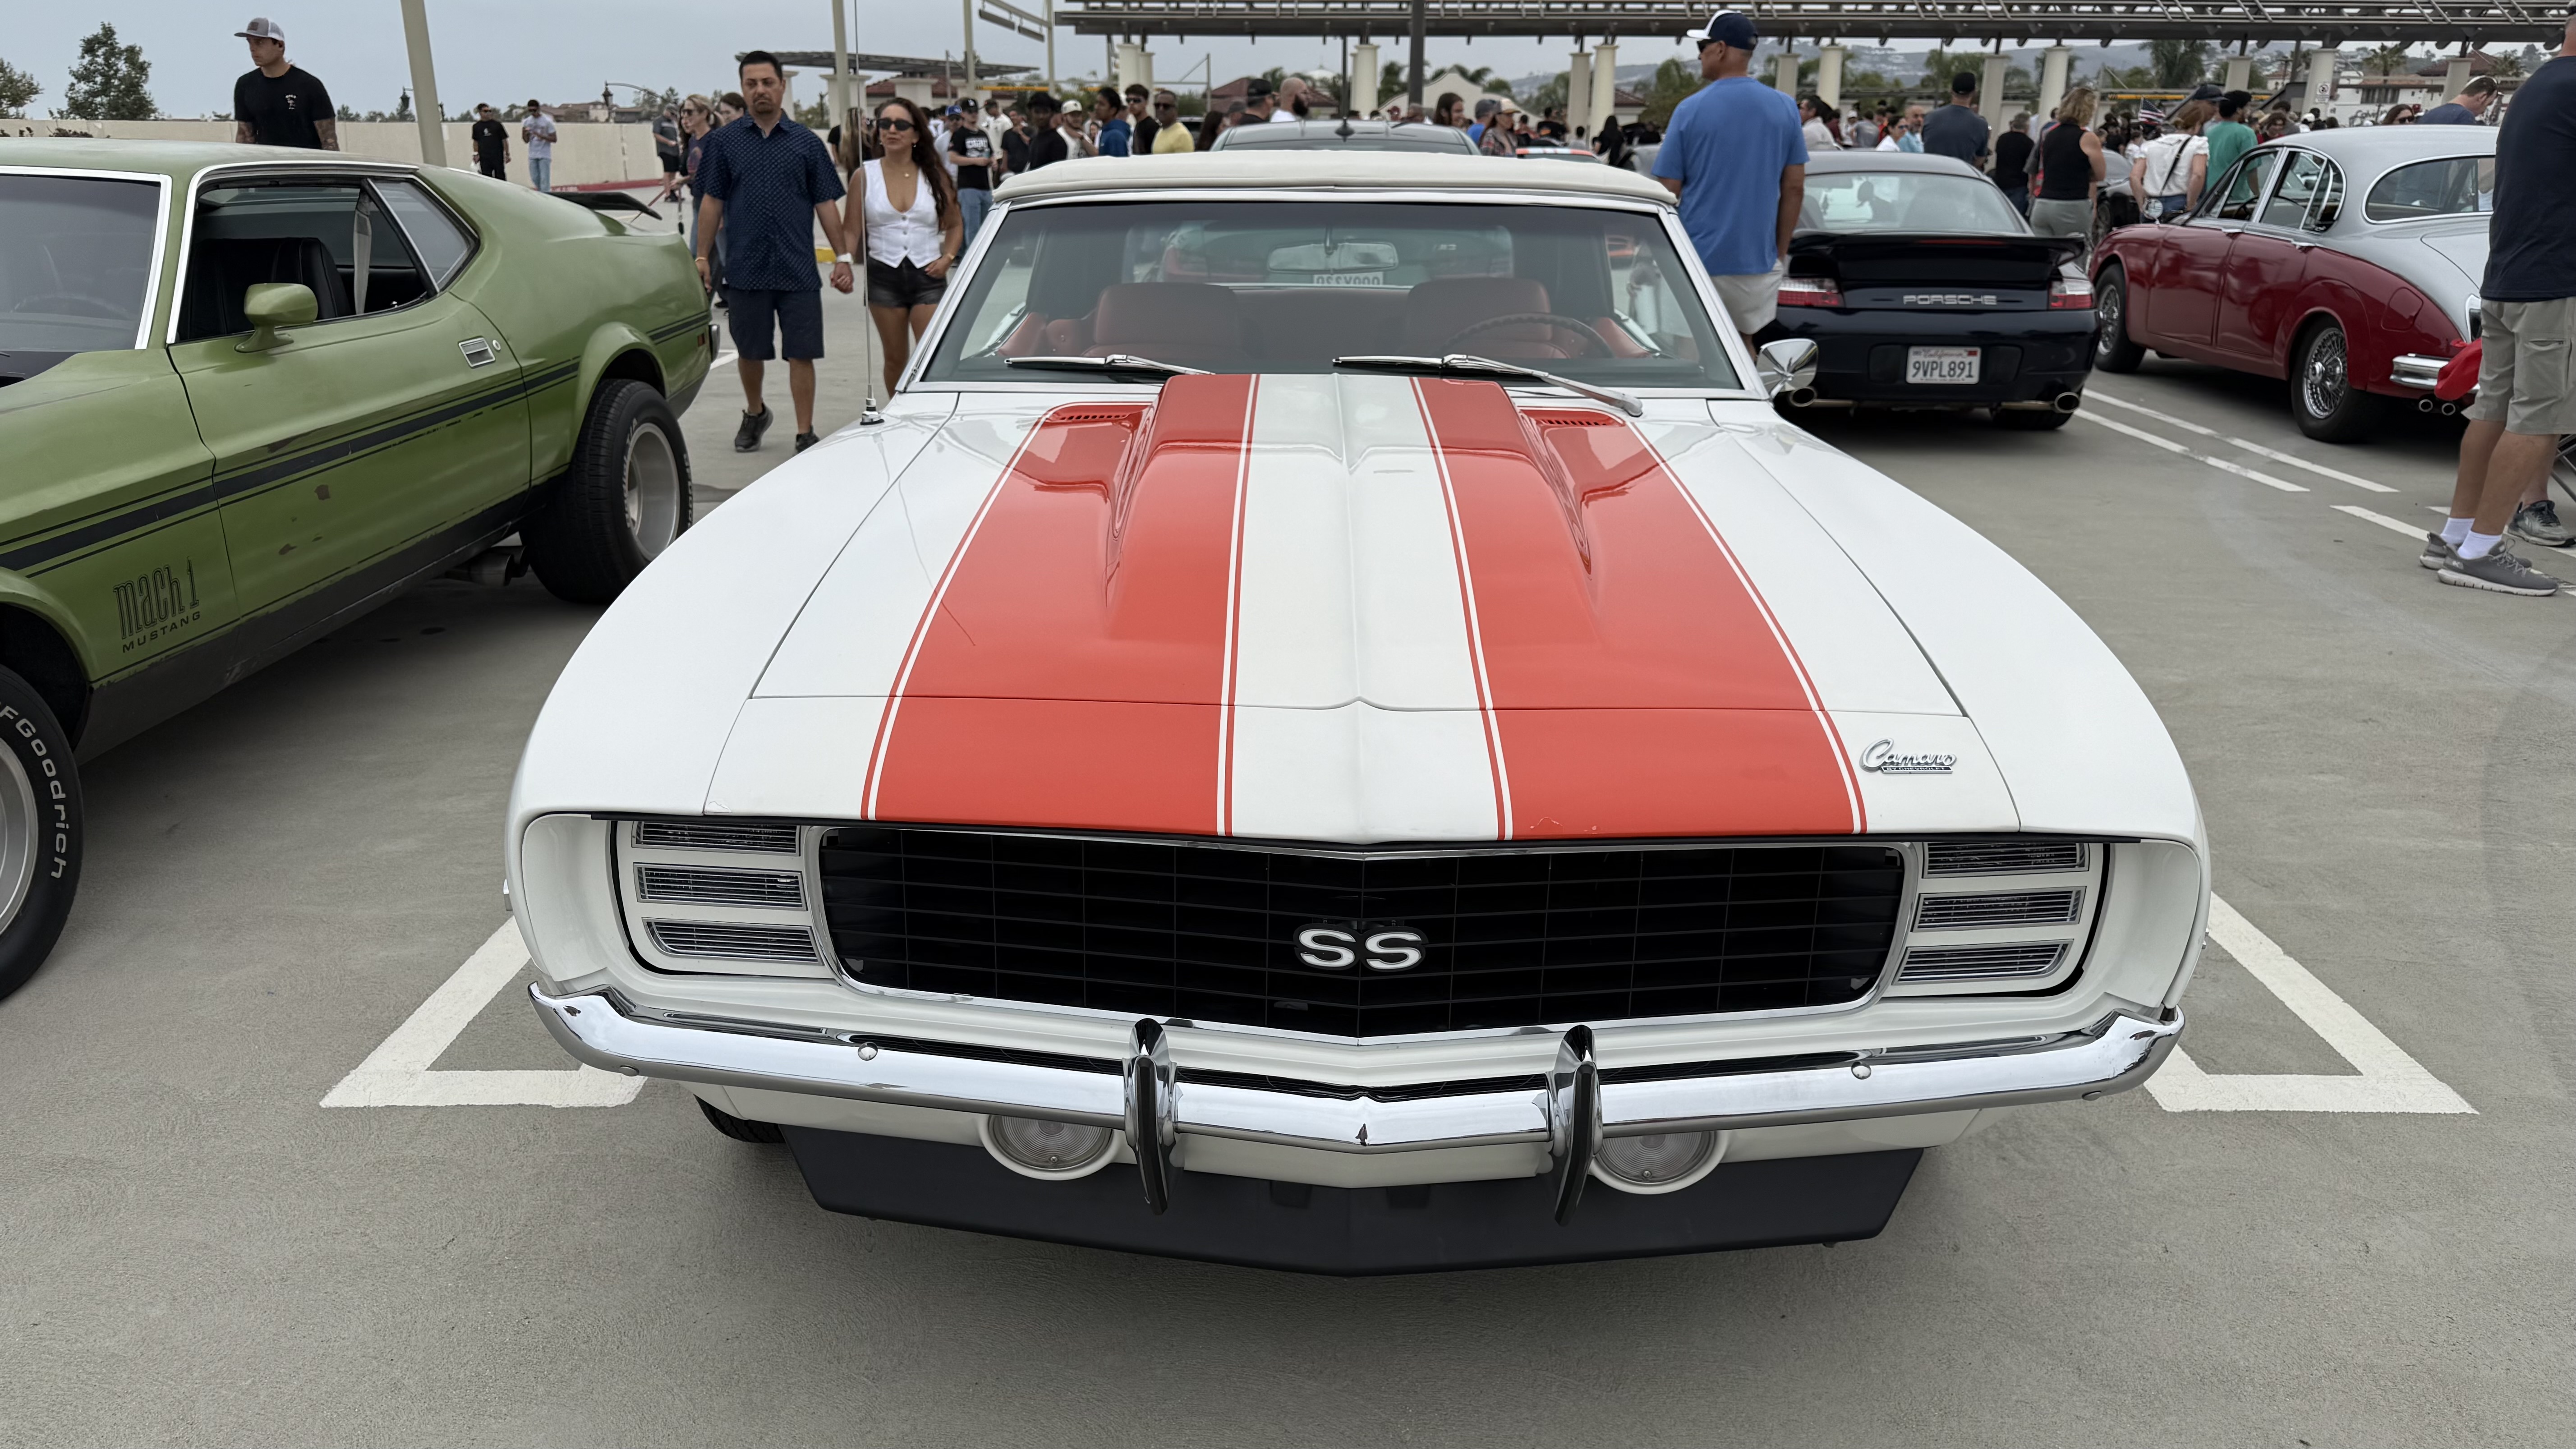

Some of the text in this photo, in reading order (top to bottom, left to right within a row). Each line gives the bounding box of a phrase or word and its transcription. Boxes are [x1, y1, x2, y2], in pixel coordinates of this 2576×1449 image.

[1903, 294, 1997, 305] PORSCHE
[1912, 360, 1974, 378] 9VPL891
[113, 556, 199, 640] mach 1
[122, 611, 201, 653] MUSTANG
[1862, 737, 1957, 769] Camaro
[0, 702, 69, 879] FGoodrich
[1299, 929, 1422, 970] SS
